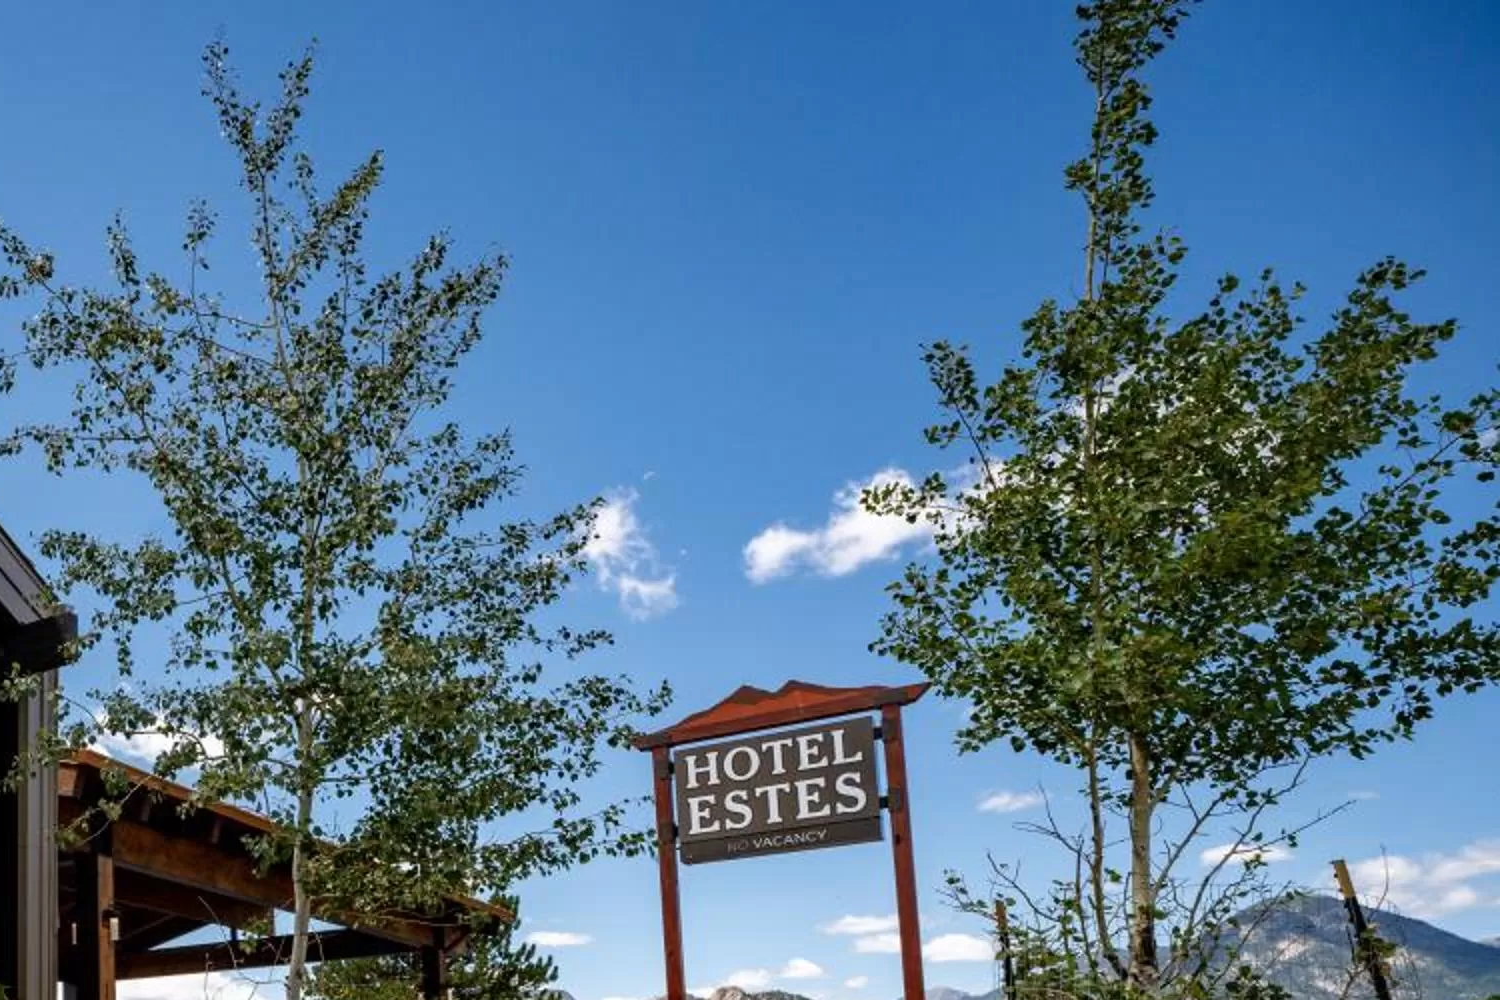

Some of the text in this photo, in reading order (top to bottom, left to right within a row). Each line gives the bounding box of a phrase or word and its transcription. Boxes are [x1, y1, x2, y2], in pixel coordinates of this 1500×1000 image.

[685, 729, 863, 789] HOTEL
[687, 772, 867, 835] ESTES
[752, 829, 828, 850] VACANCY
